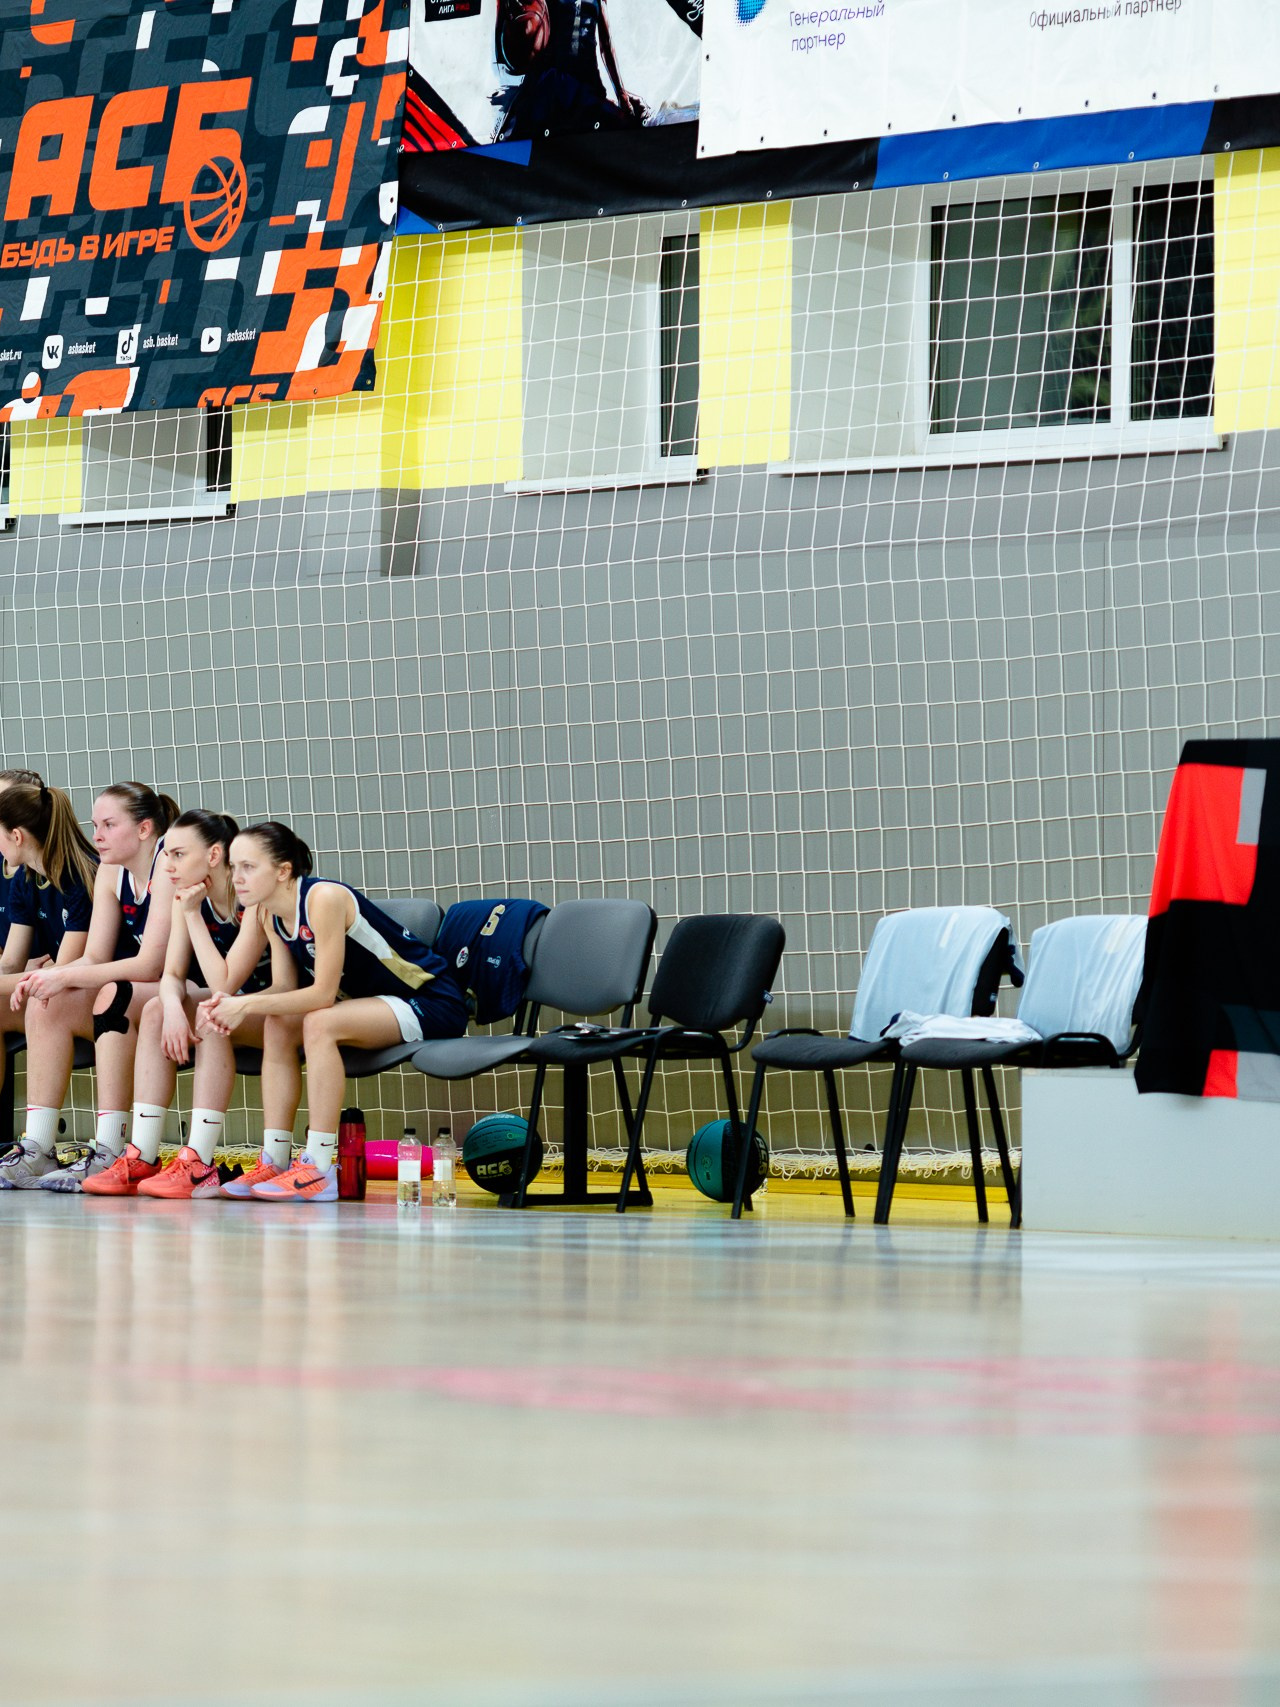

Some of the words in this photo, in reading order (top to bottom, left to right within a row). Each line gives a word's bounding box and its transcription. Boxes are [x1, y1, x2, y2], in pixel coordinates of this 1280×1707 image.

[789, 0, 885, 27] Генеральный
[1029, 1, 1122, 31] Официальный
[791, 32, 846, 54] партнер
[4, 76, 252, 222] АСБ
[0, 237, 75, 269] БУДЬ
[78, 234, 100, 261] В
[102, 226, 175, 259] ИГРЕ
[226, 327, 257, 342] asbasket
[67, 341, 97, 355] asbasket
[476, 1159, 513, 1176] АСБ
